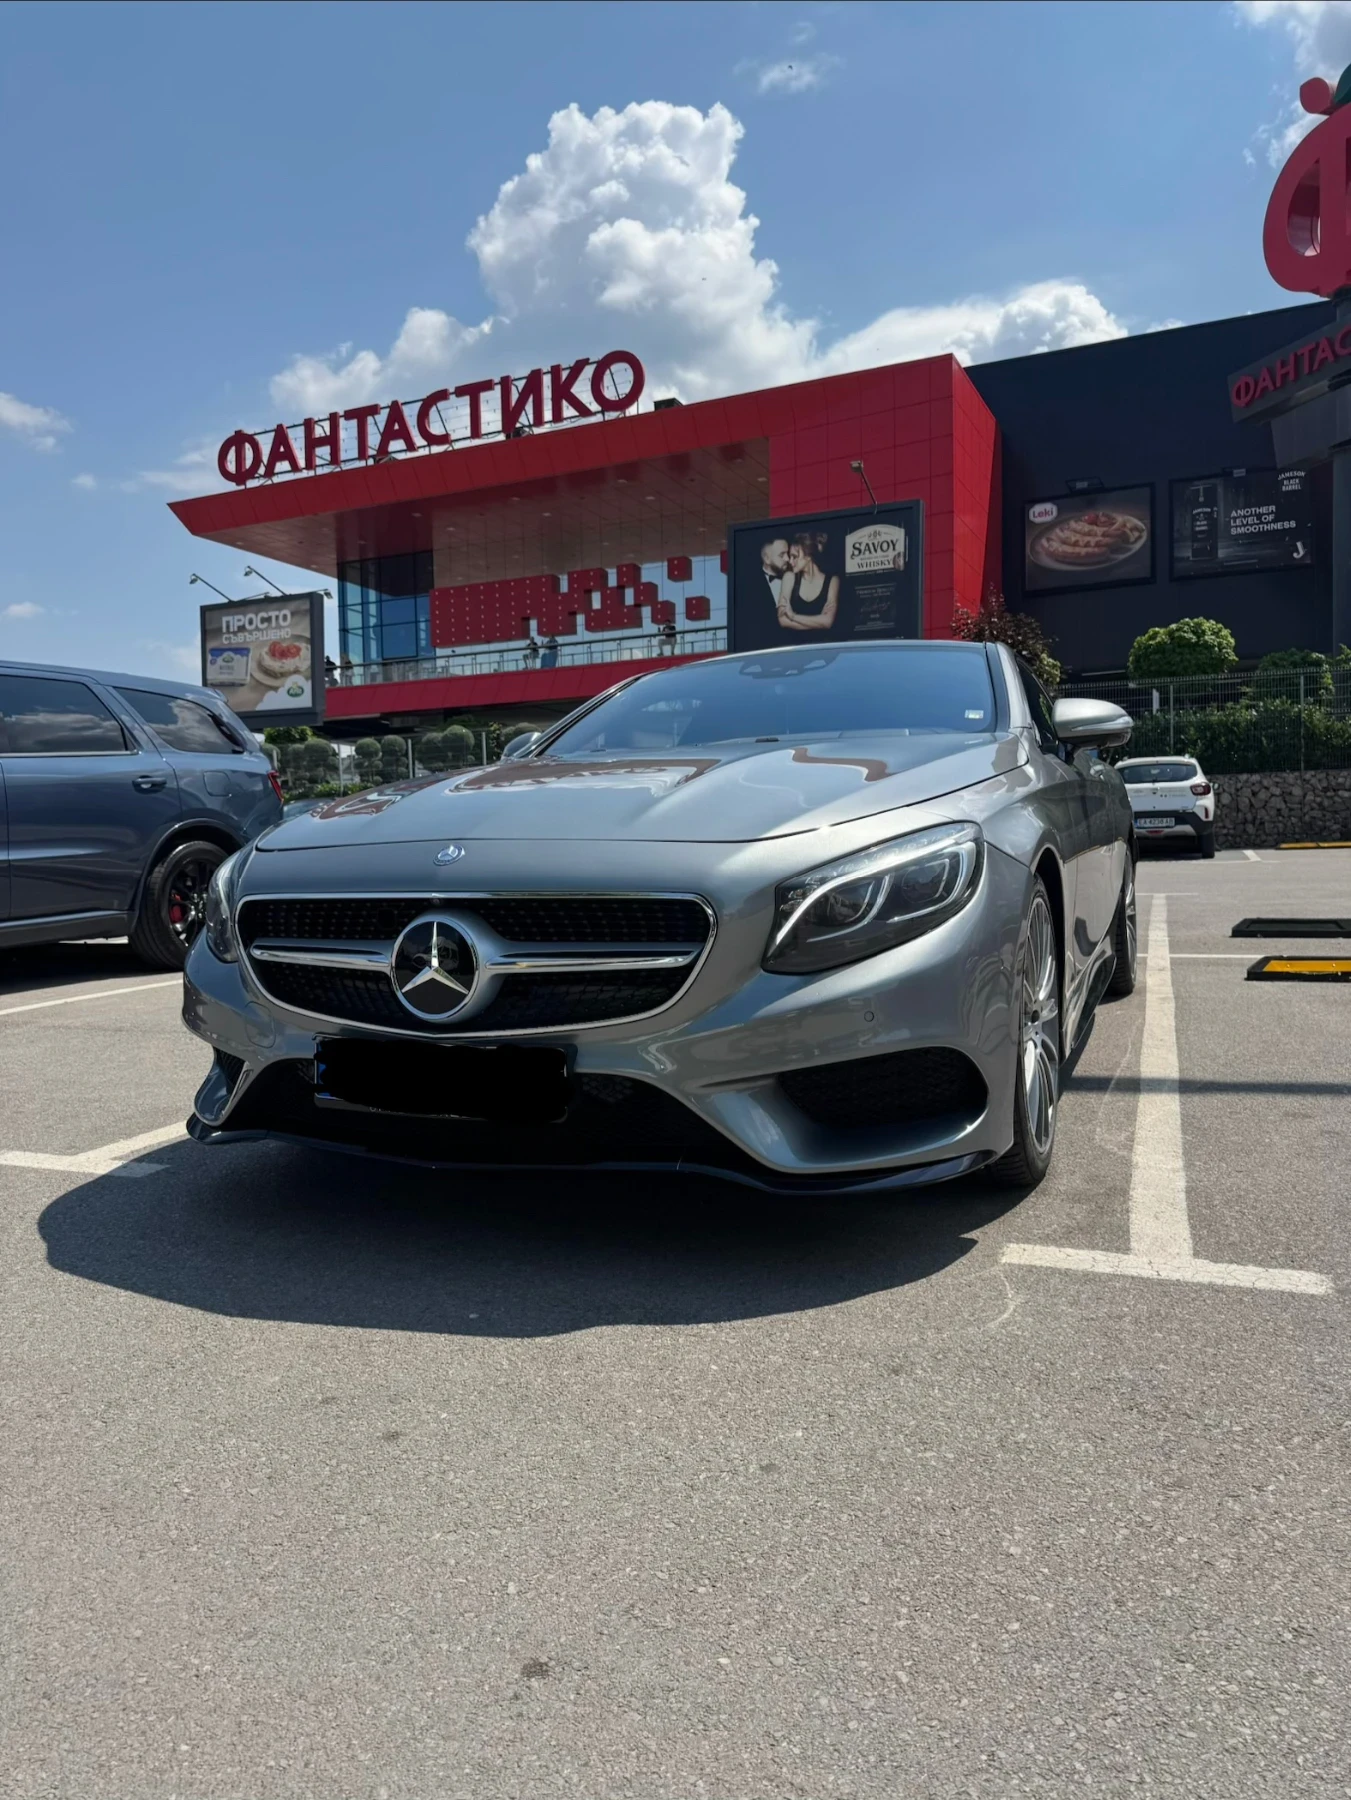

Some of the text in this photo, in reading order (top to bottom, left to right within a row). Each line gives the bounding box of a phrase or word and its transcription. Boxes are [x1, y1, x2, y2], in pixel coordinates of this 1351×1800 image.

[218, 350, 646, 486] ФАНТАСТИКО
[1278, 471, 1305, 480] JAMESON
[1231, 505, 1275, 517] ANOTHER
[1230, 520, 1296, 535] SMOOTHNESS
[1231, 514, 1275, 526] LEVEL OF
[850, 539, 899, 560] SAVOY
[857, 559, 892, 570] WHISKY
[222, 609, 291, 633] ПРОСТО
[222, 628, 291, 644] СЪВЪРШЕНО
